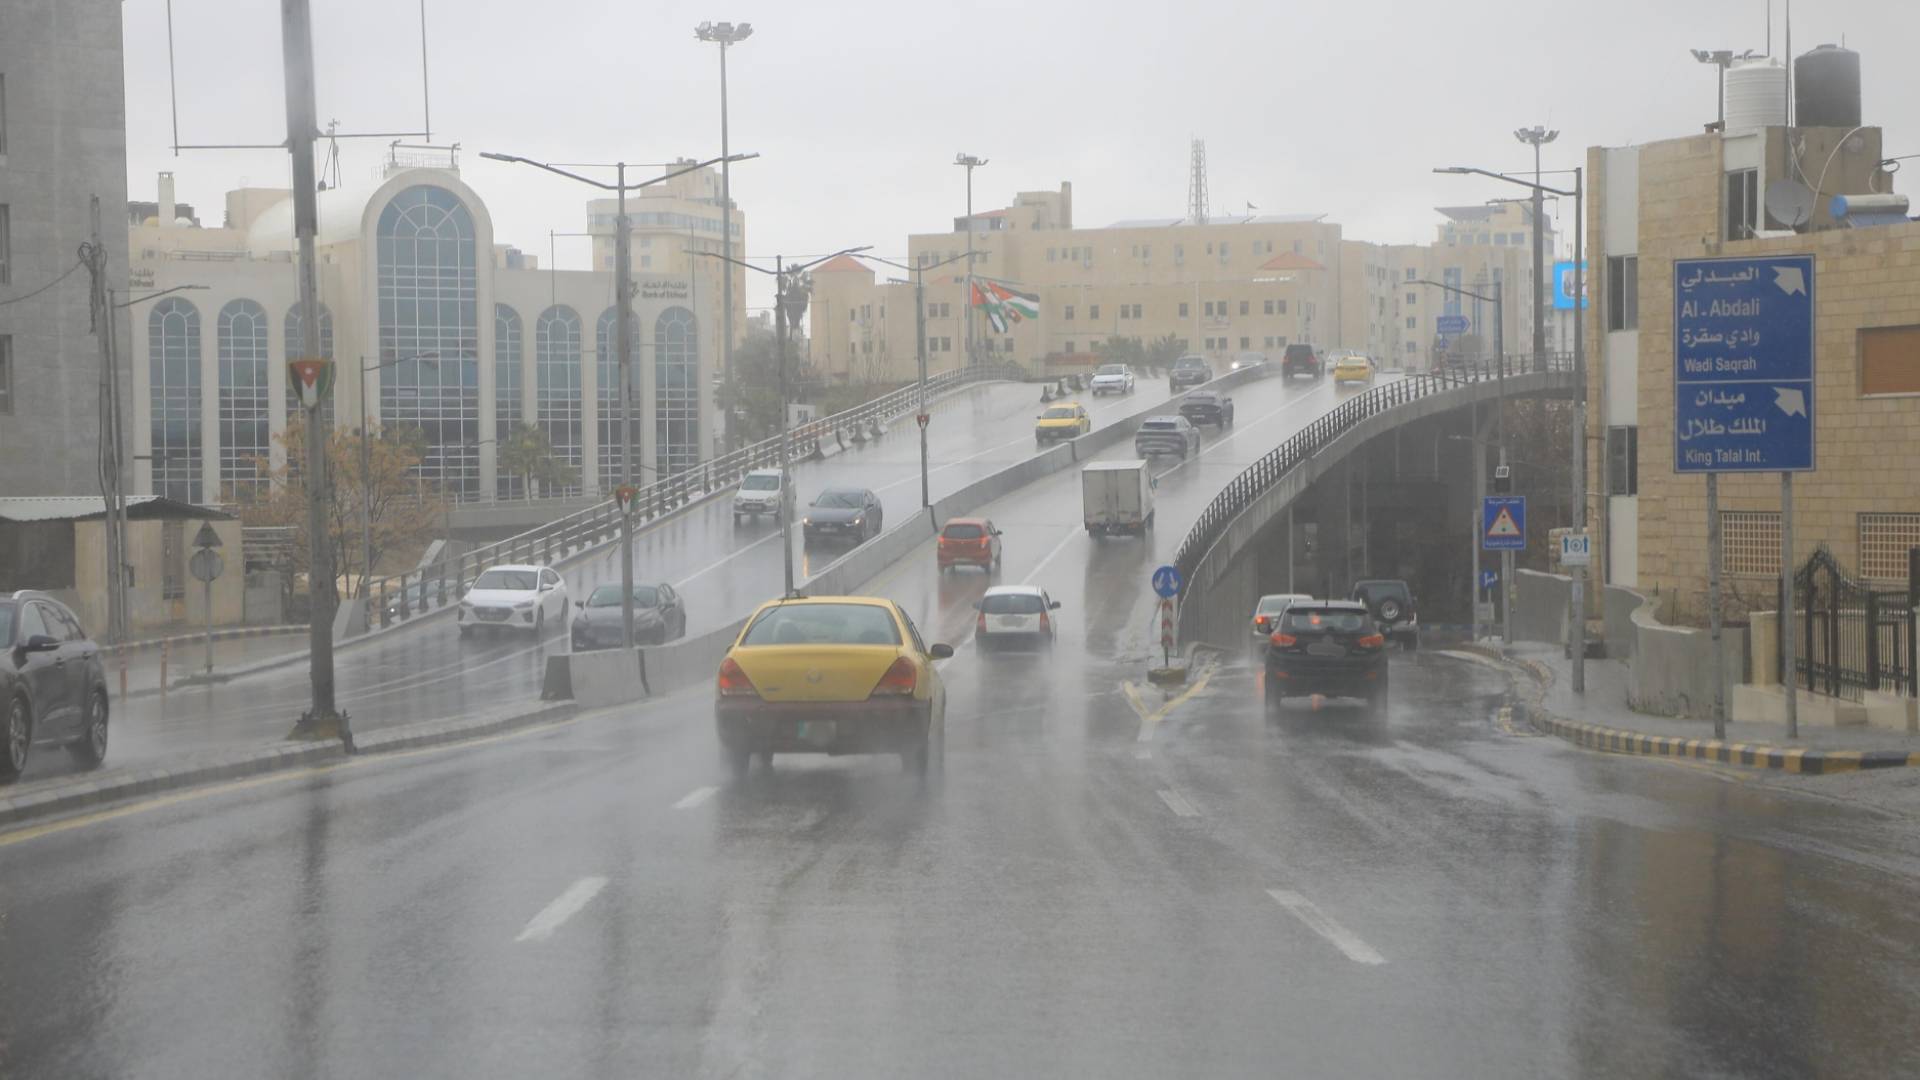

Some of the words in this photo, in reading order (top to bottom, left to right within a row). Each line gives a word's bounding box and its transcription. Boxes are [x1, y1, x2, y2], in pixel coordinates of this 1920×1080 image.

[1681, 266, 1759, 292] العبدلي
[1710, 298, 1760, 317] Abdali
[1682, 328, 1723, 348] صقرة
[1726, 328, 1760, 349] وادي
[1684, 358, 1712, 373] Wadi
[1716, 356, 1757, 374] Saqrah
[1695, 390, 1745, 410] ميدان
[1680, 418, 1725, 440] طلال
[1727, 418, 1766, 434] الملك
[1685, 449, 1712, 466] King
[1715, 448, 1742, 462] Talal
